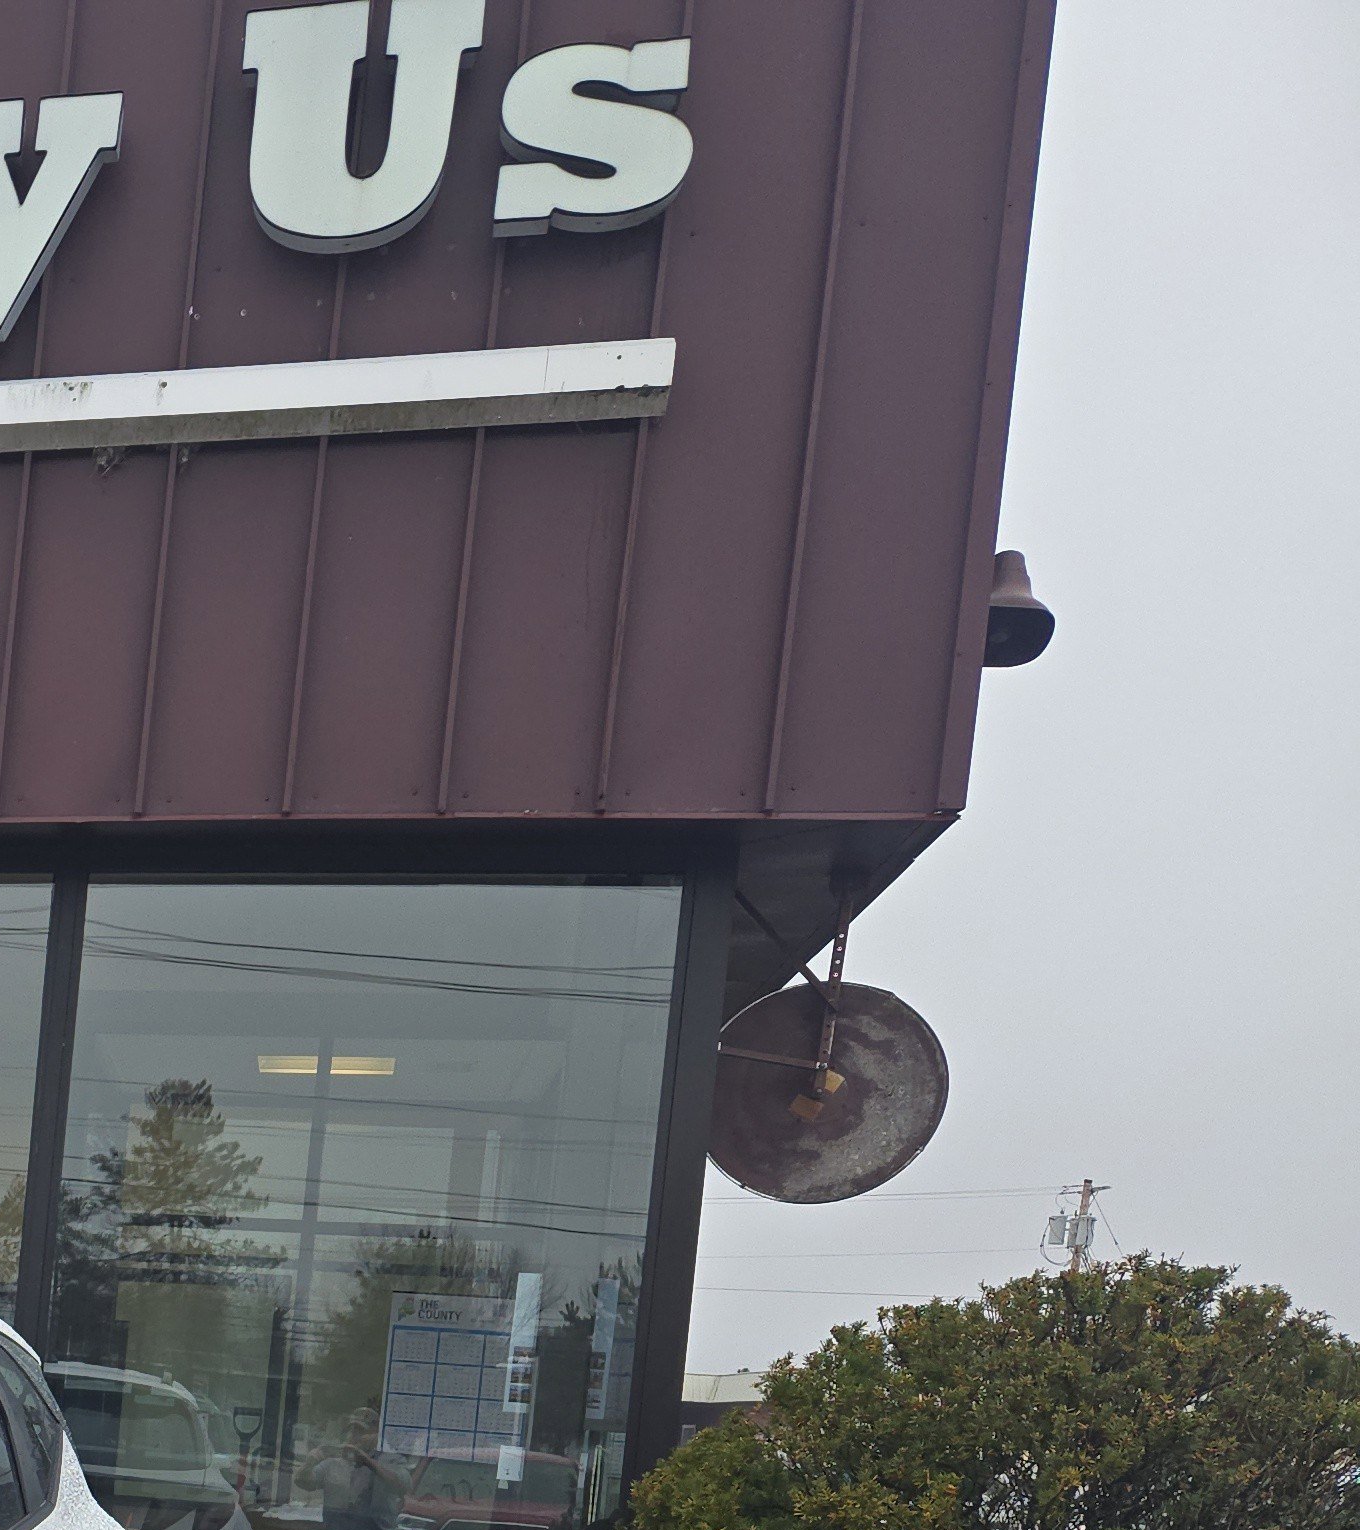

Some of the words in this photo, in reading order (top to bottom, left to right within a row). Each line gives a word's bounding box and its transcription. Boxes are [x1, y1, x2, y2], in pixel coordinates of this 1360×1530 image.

[243, 0, 696, 256] Us
[419, 1298, 440, 1309] THE
[417, 1309, 464, 1321] COUNTY
